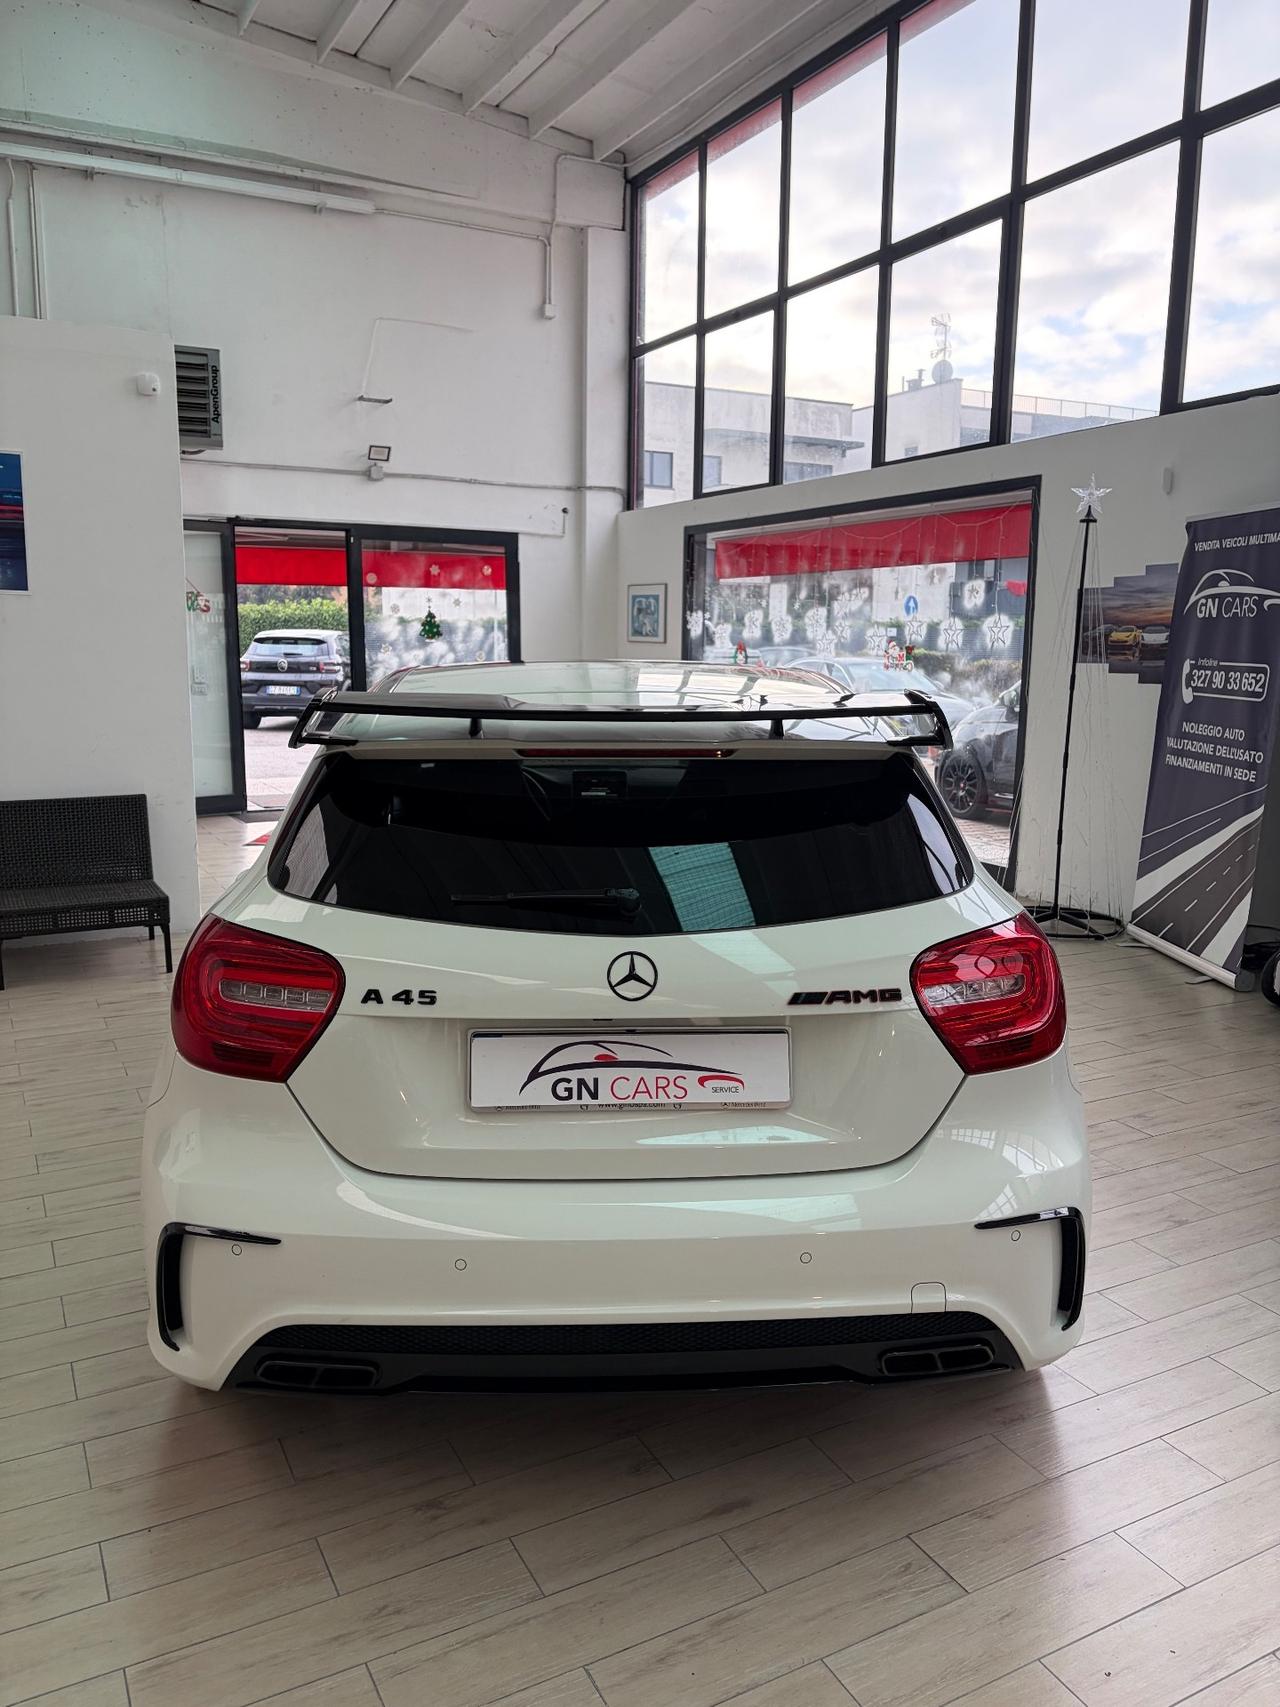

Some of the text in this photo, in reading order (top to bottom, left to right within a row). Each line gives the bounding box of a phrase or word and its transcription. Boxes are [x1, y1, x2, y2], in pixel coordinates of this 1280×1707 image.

[211, 365, 220, 424] ApenGroup
[1194, 539, 1220, 551] VENDITA
[1222, 536, 1248, 548] VEICOLI
[1196, 596, 1259, 618] GN CARS
[1191, 669, 1265, 692] 327 90 33 652
[1182, 721, 1245, 741] NOLEGGIO AUTO
[1166, 736, 1264, 764] VALUTAZIONE DELL'USATO
[1165, 754, 1257, 782] FINANZIAMENTI IN SEDE
[360, 988, 437, 1005] A 45
[824, 988, 902, 1005] AMG
[551, 1075, 688, 1101] GN CARS
[711, 1085, 739, 1094] SERVICE
